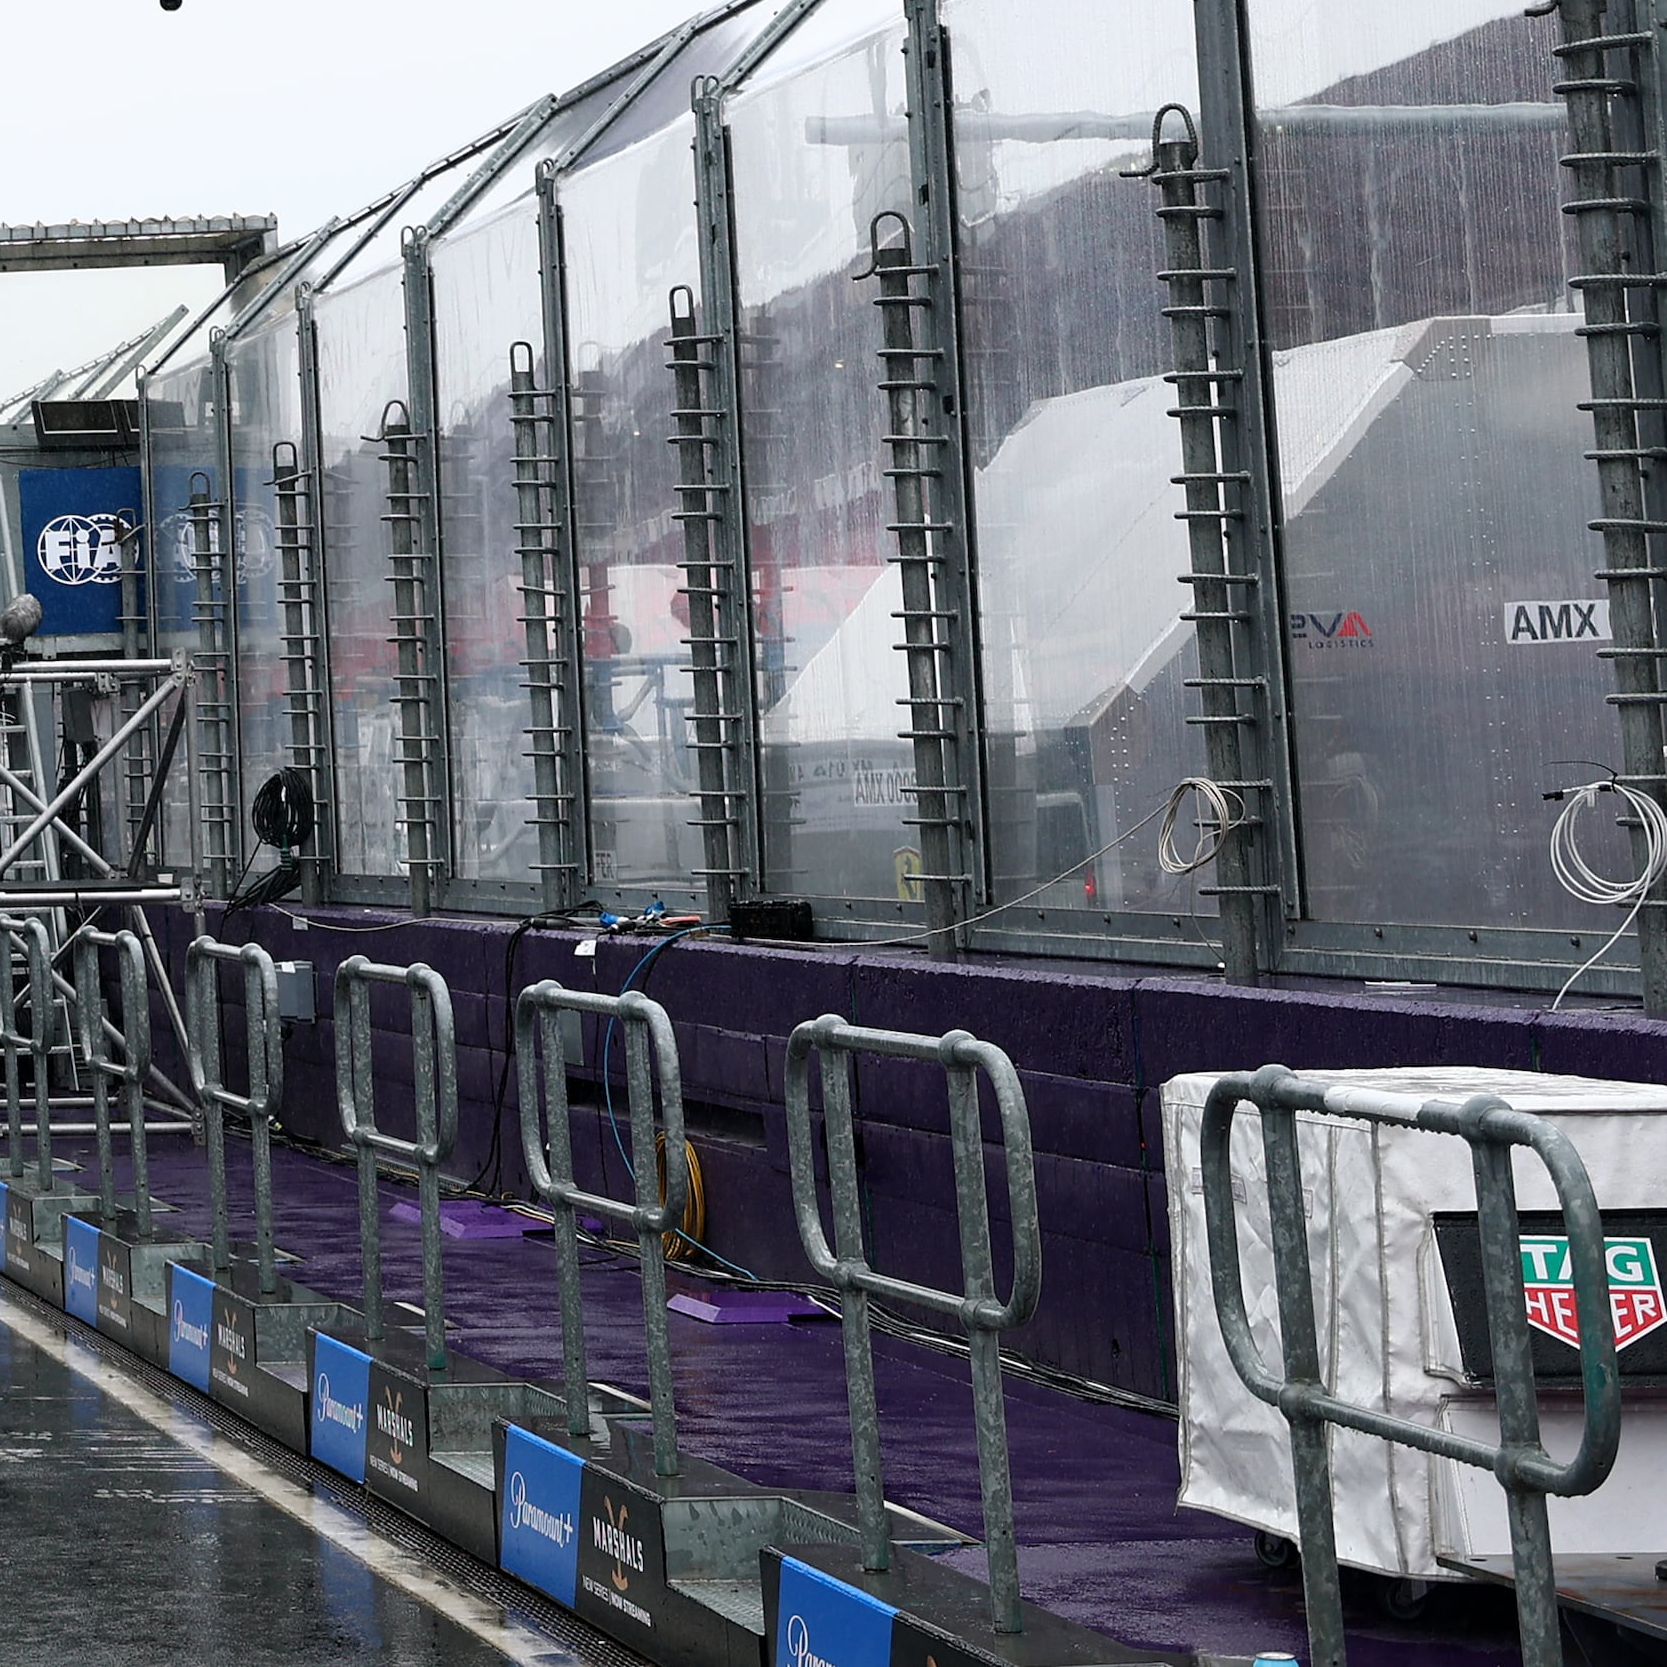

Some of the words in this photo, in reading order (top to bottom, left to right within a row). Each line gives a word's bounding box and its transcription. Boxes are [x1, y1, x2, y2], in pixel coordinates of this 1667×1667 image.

[1512, 603, 1600, 641] AMX
[1308, 640, 1375, 650] LOGISTICS
[1524, 1292, 1657, 1339] HEER
[218, 1323, 246, 1359] MARSHALS
[317, 1372, 364, 1434] Paramount+
[376, 1403, 413, 1447] MARSHALS
[510, 1471, 573, 1548] Paramount+
[592, 1517, 644, 1573] MARSHALS
[623, 1598, 652, 1627] STREAMING
